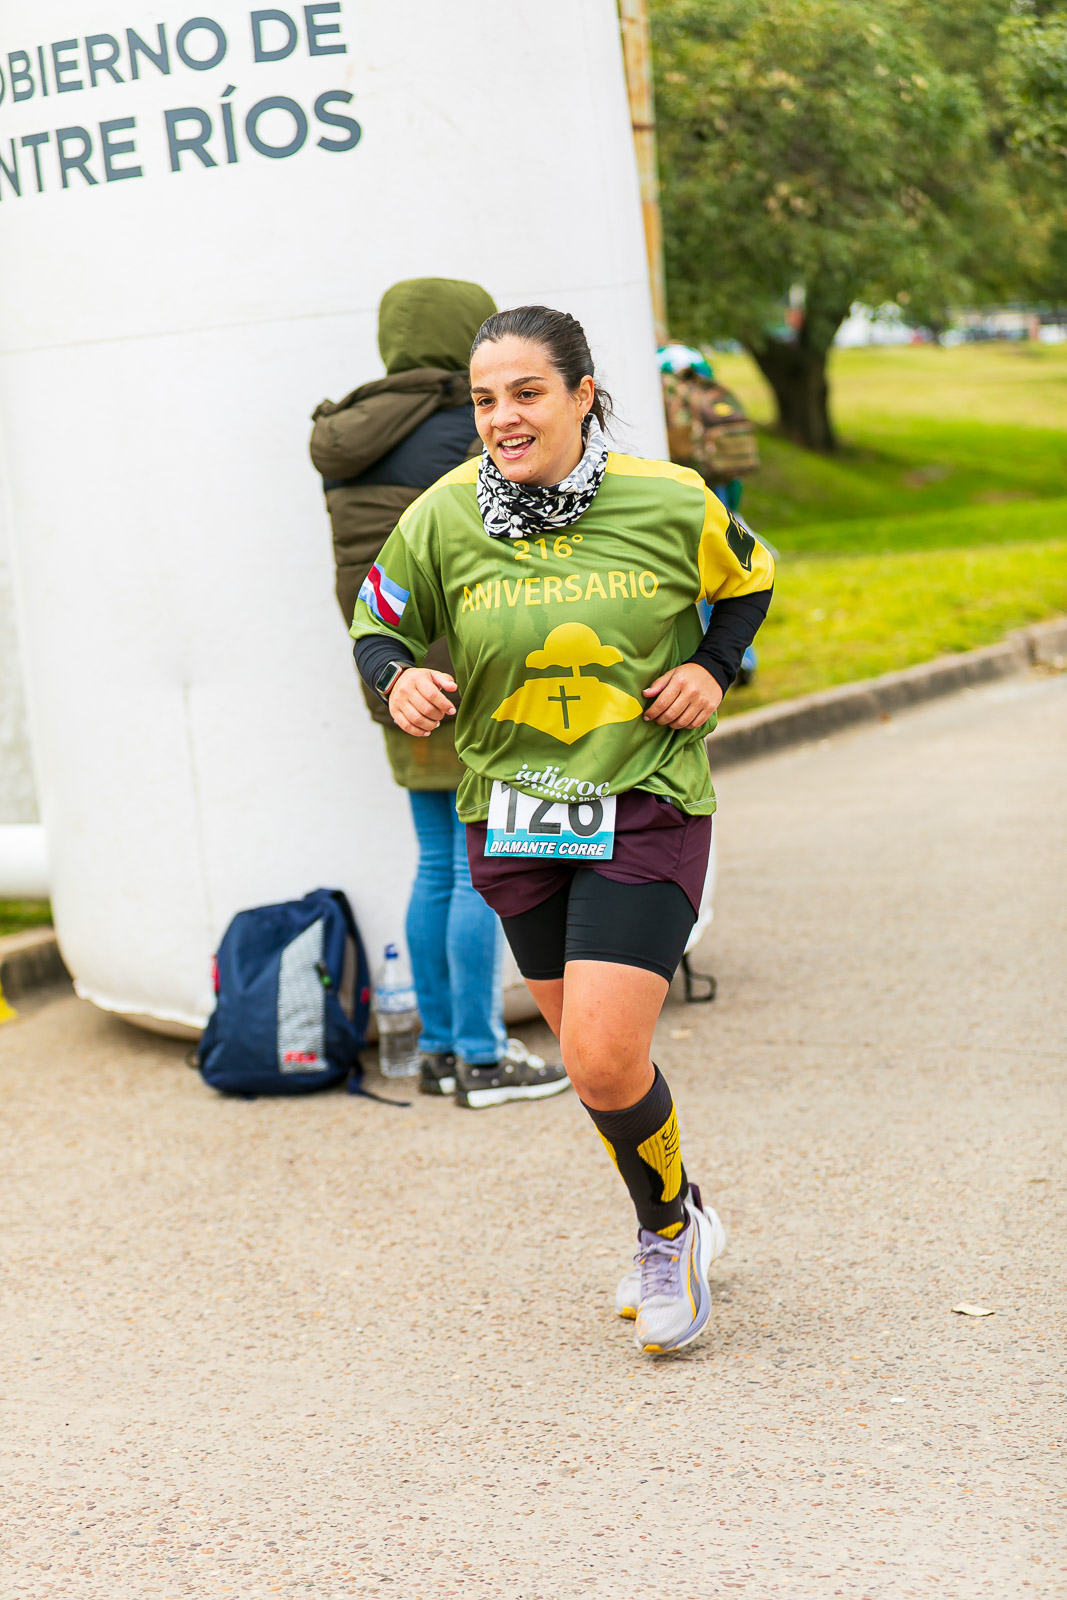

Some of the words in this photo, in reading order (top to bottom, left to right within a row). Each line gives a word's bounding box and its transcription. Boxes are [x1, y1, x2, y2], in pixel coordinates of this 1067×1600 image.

[0, 17, 228, 105] BIERNO
[251, 2, 348, 63] DE
[164, 84, 361, 172] RÍOS
[513, 534, 584, 560] 216°
[461, 570, 660, 613] ANIVERSARIO
[500, 782, 604, 837] 126
[489, 840, 557, 855] DIAMANTE
[558, 842, 607, 856] CORRE
